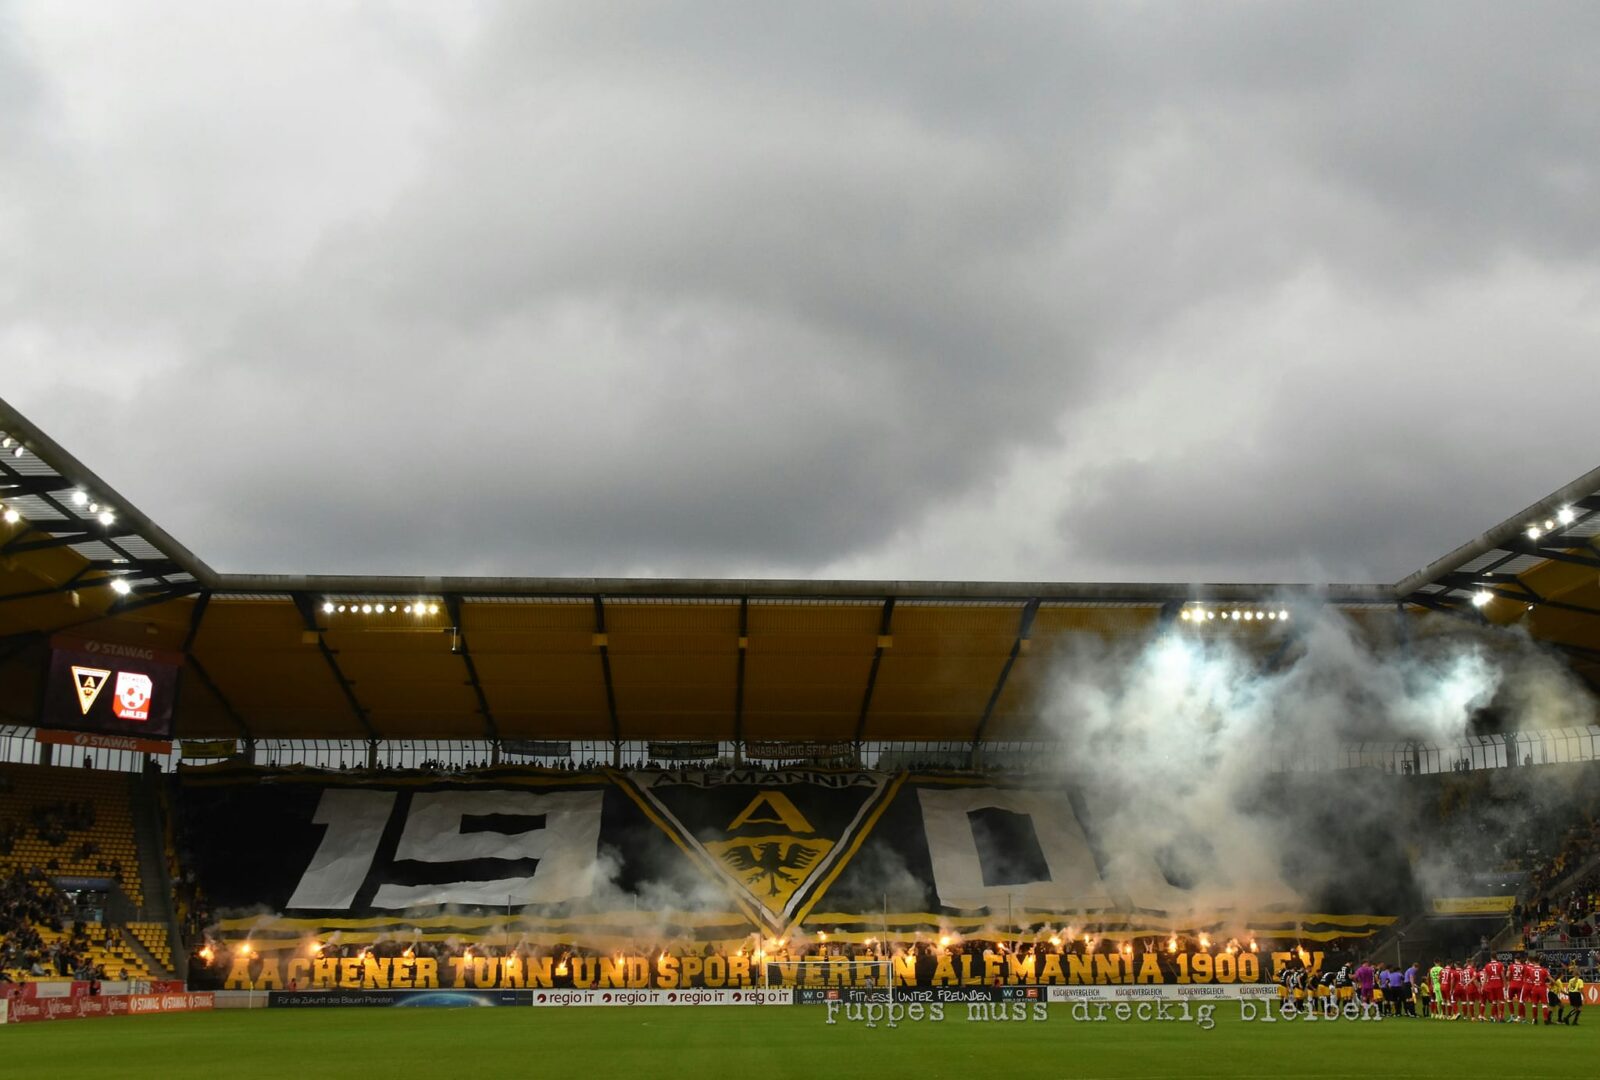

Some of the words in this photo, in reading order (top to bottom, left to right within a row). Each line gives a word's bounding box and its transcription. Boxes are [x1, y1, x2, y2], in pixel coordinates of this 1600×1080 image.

[101, 643, 153, 660] STAWAG
[90, 736, 137, 749] STAWAG
[652, 771, 876, 788] ALEMANNIA
[224, 957, 439, 989] AACHENER
[930, 953, 1164, 986] ALEMANNIA
[1176, 952, 1260, 984] 1900
[614, 991, 646, 1005] regio
[680, 991, 711, 1005] regio
[744, 991, 776, 1004] rego
[898, 990, 933, 1002] UNTER
[938, 990, 992, 1002] FREUNDEN
[1052, 988, 1100, 997] KÜCHENVERGLEICH
[1115, 988, 1163, 997] KÜCHENVERGLEICH
[1177, 987, 1225, 996] KÜCHENVERGLEICH
[1239, 987, 1279, 996] KÜCHENVERGLE
[301, 996, 326, 1004] Zukunft
[549, 992, 581, 1005] regio
